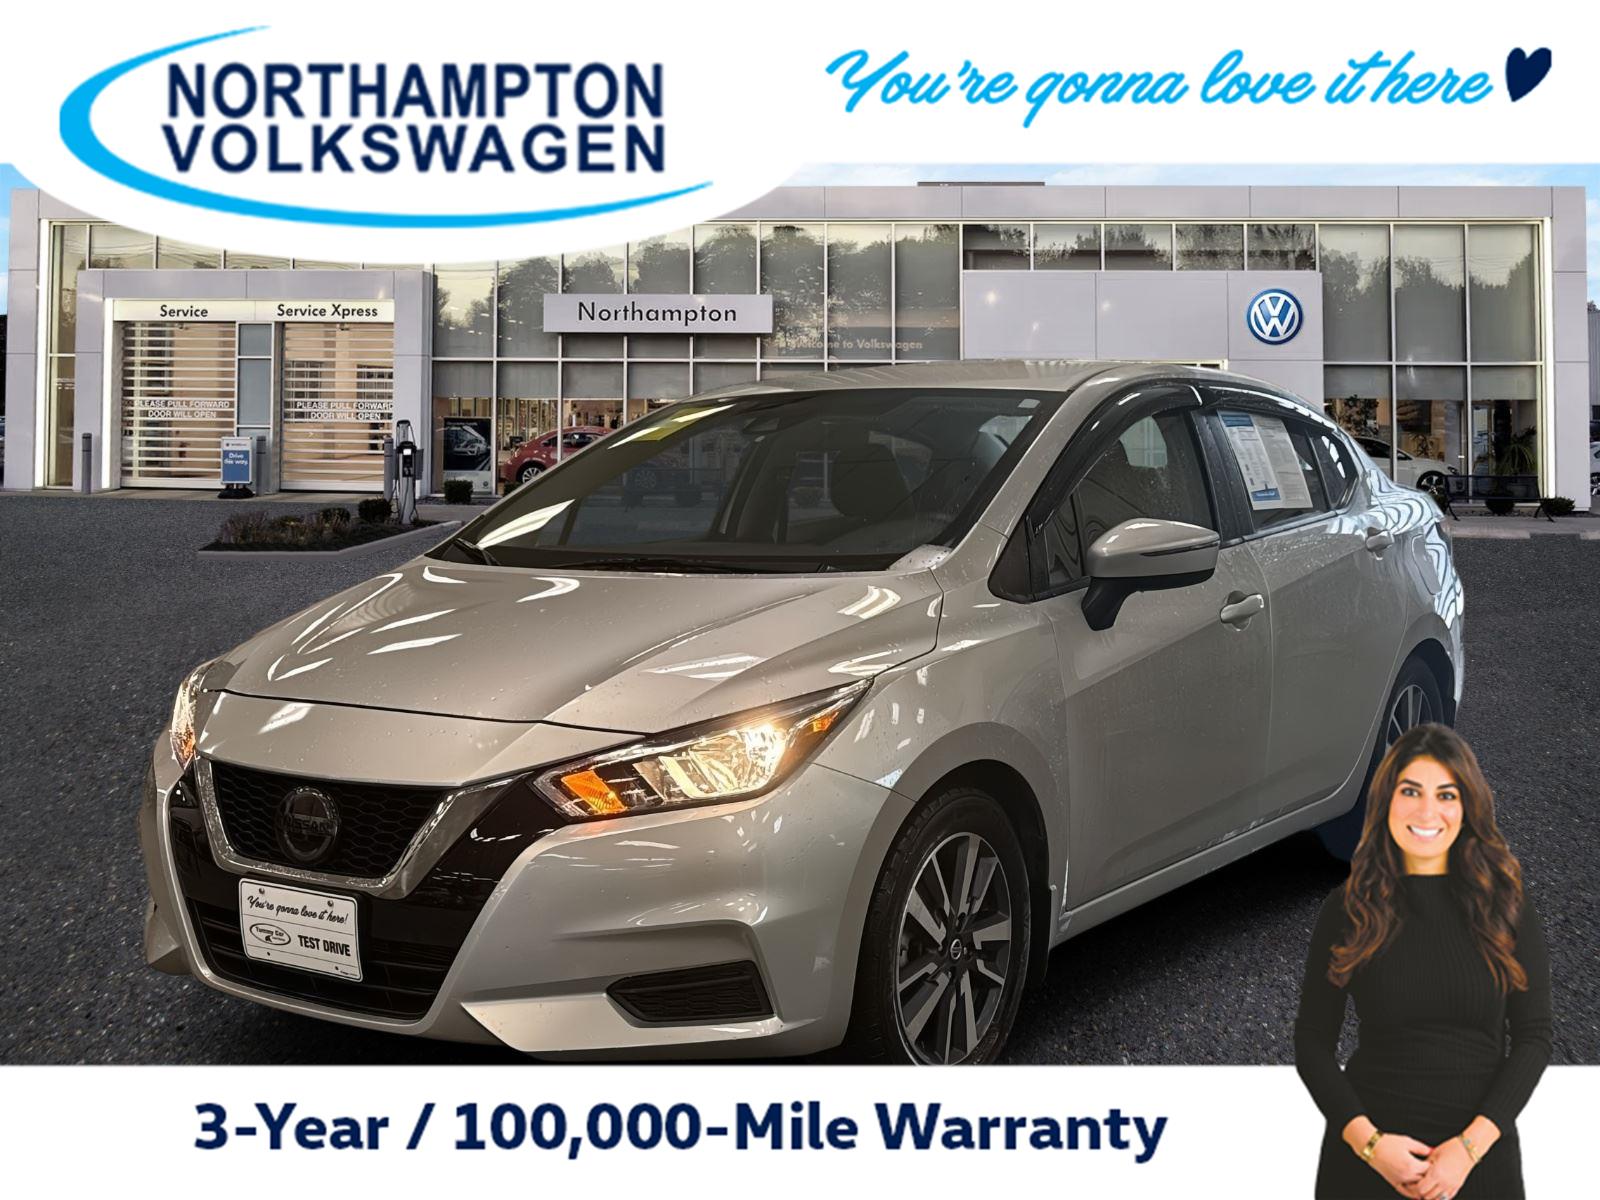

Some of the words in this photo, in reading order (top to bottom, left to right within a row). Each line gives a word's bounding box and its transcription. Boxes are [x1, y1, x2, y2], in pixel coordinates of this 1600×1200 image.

[159, 304, 209, 318] Service
[277, 303, 327, 317] Service
[331, 303, 379, 320] Xpress
[578, 302, 737, 327] Northampton
[148, 410, 172, 418] DOOR
[174, 410, 192, 418] WILL
[194, 410, 217, 418] OPEN
[247, 895, 274, 910] You're
[275, 904, 299, 916] gonna
[300, 905, 317, 919] love
[318, 909, 327, 920] it
[326, 911, 349, 924] here!
[298, 935, 320, 950] TEST
[323, 940, 352, 957] DRIVE
